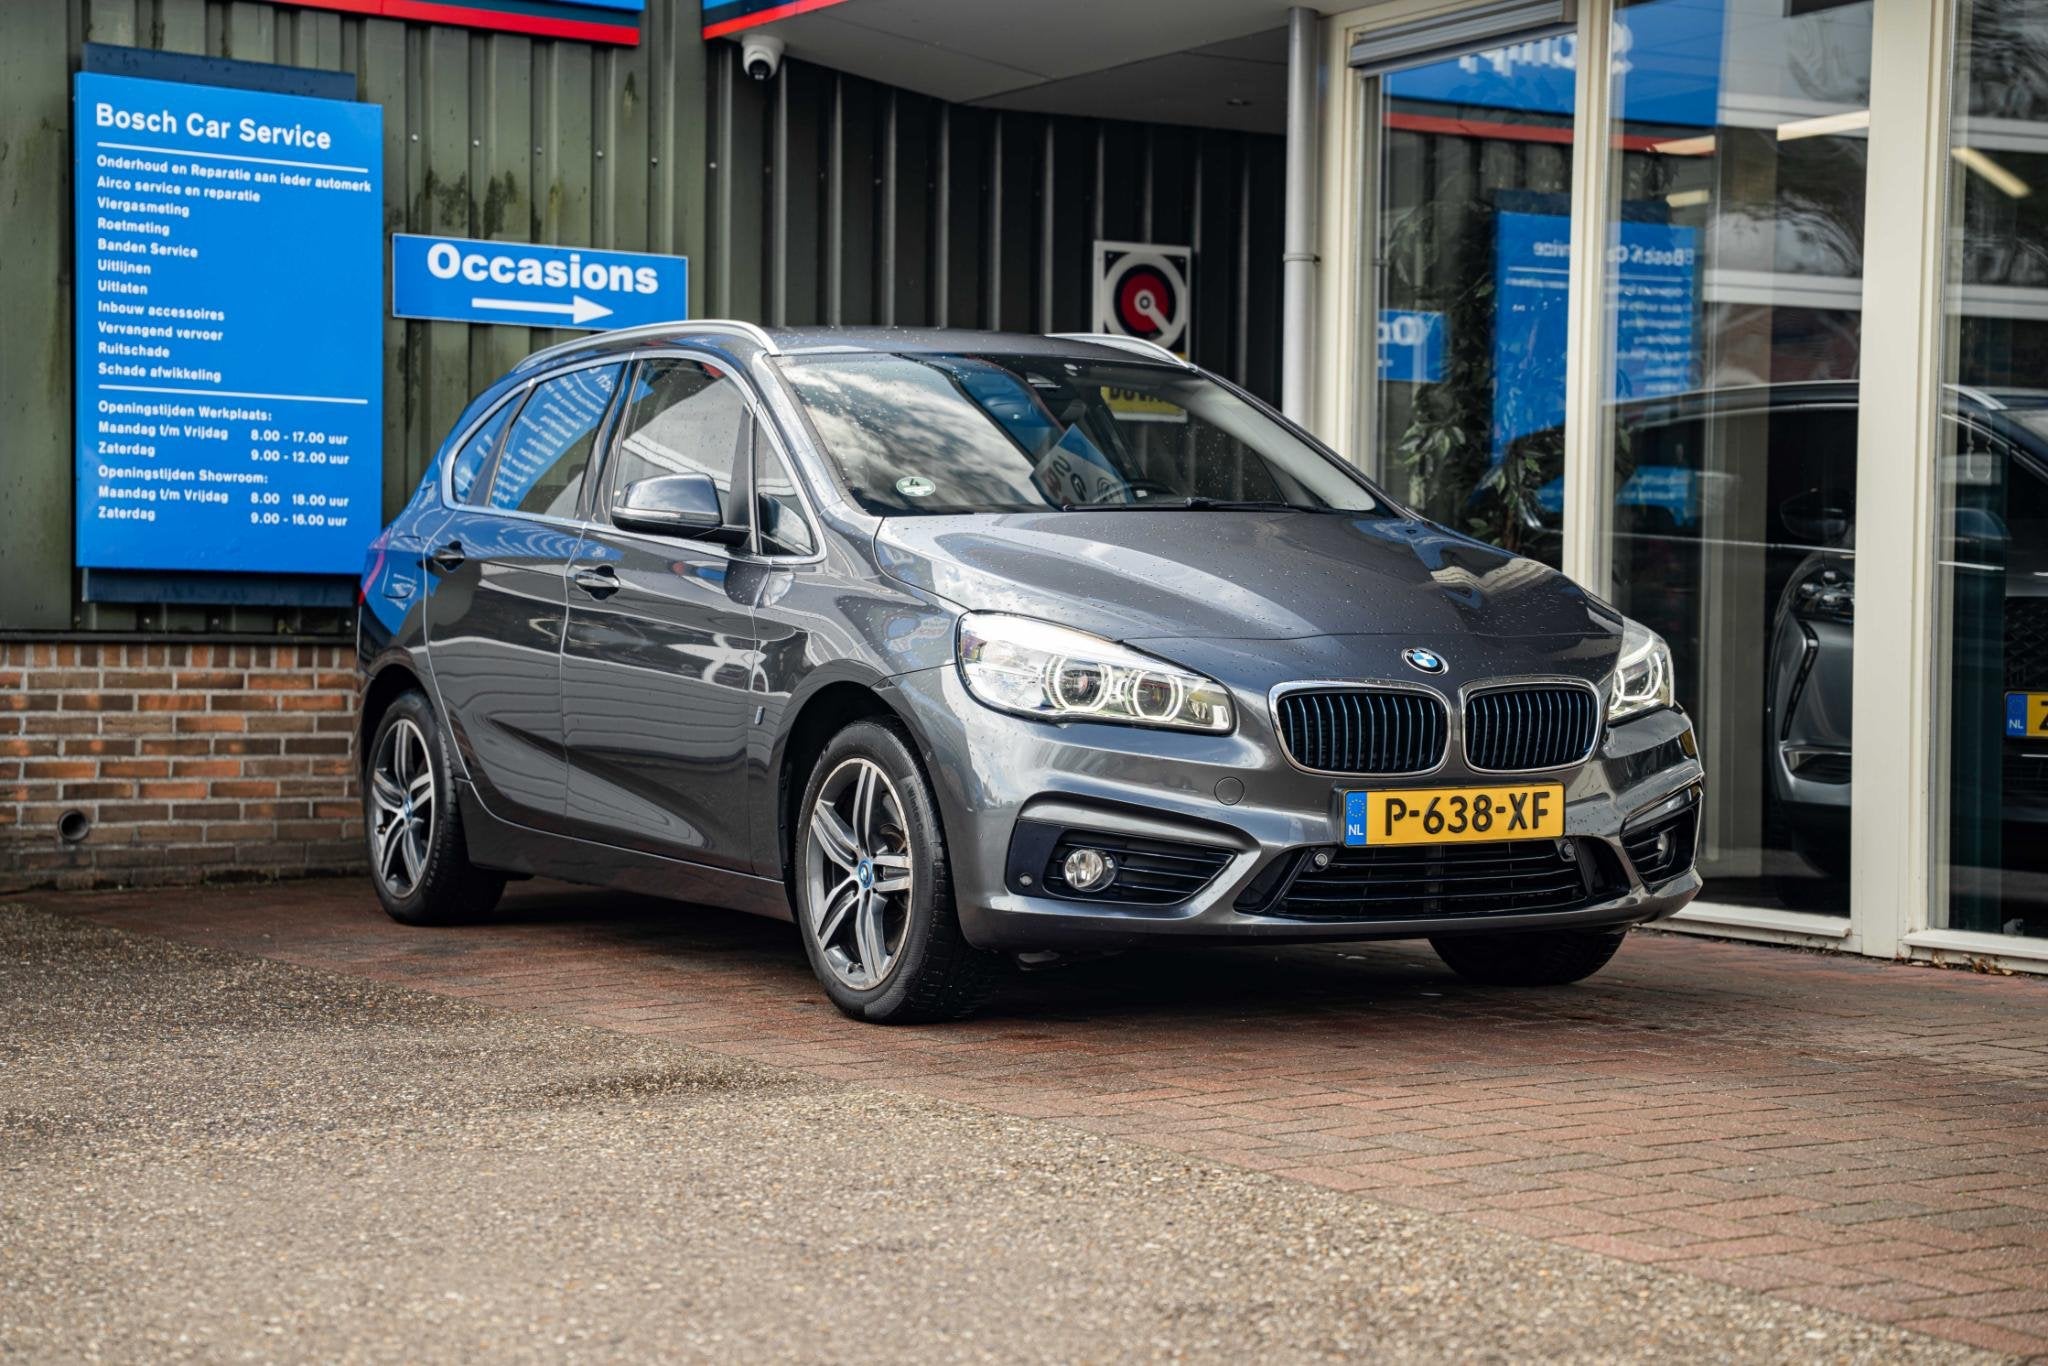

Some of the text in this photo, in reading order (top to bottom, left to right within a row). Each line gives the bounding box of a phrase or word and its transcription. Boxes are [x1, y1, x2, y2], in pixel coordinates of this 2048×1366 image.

[95, 102, 331, 150] Bosch Car Service
[96, 154, 371, 192] Onderhoud en Reparatie aan ieder automerk
[96, 175, 260, 202] Airco service en reparatie
[96, 196, 189, 218] Viergasmeting
[97, 216, 170, 236] Roetmeting
[97, 237, 198, 258] Banden Service
[97, 258, 151, 274] Uitlijnen
[427, 243, 658, 294] Occasions
[97, 279, 148, 294] Uitlaten
[97, 300, 224, 321] Inbouw accessoires
[97, 320, 223, 341] Vervangend vervoer
[98, 341, 170, 358] Ruitschade
[98, 361, 221, 383] Schade afwikkeling
[97, 399, 271, 421] Openingstijden Werkplaats:
[98, 420, 156, 437] Maandag
[159, 423, 180, 436] t/m
[183, 425, 228, 440] Vrijdag
[250, 428, 280, 442] 8.00
[292, 430, 325, 444] 17.00
[328, 435, 348, 445] uur
[97, 440, 155, 458] Zaterdag
[250, 448, 280, 461] 9.00
[292, 450, 326, 464] 12.00
[328, 455, 349, 464] uur
[97, 463, 267, 483] Openingstijden Showroom:
[97, 484, 349, 507] Maandag t/m Vrijdag 8.00 18.00 uur
[97, 505, 155, 521] Zaterdag
[250, 511, 280, 524] 9.00
[292, 513, 324, 526] 16.00
[327, 517, 347, 526] uur
[2008, 719, 2024, 729] NL
[1348, 791, 1551, 836] NL P-638-XF
